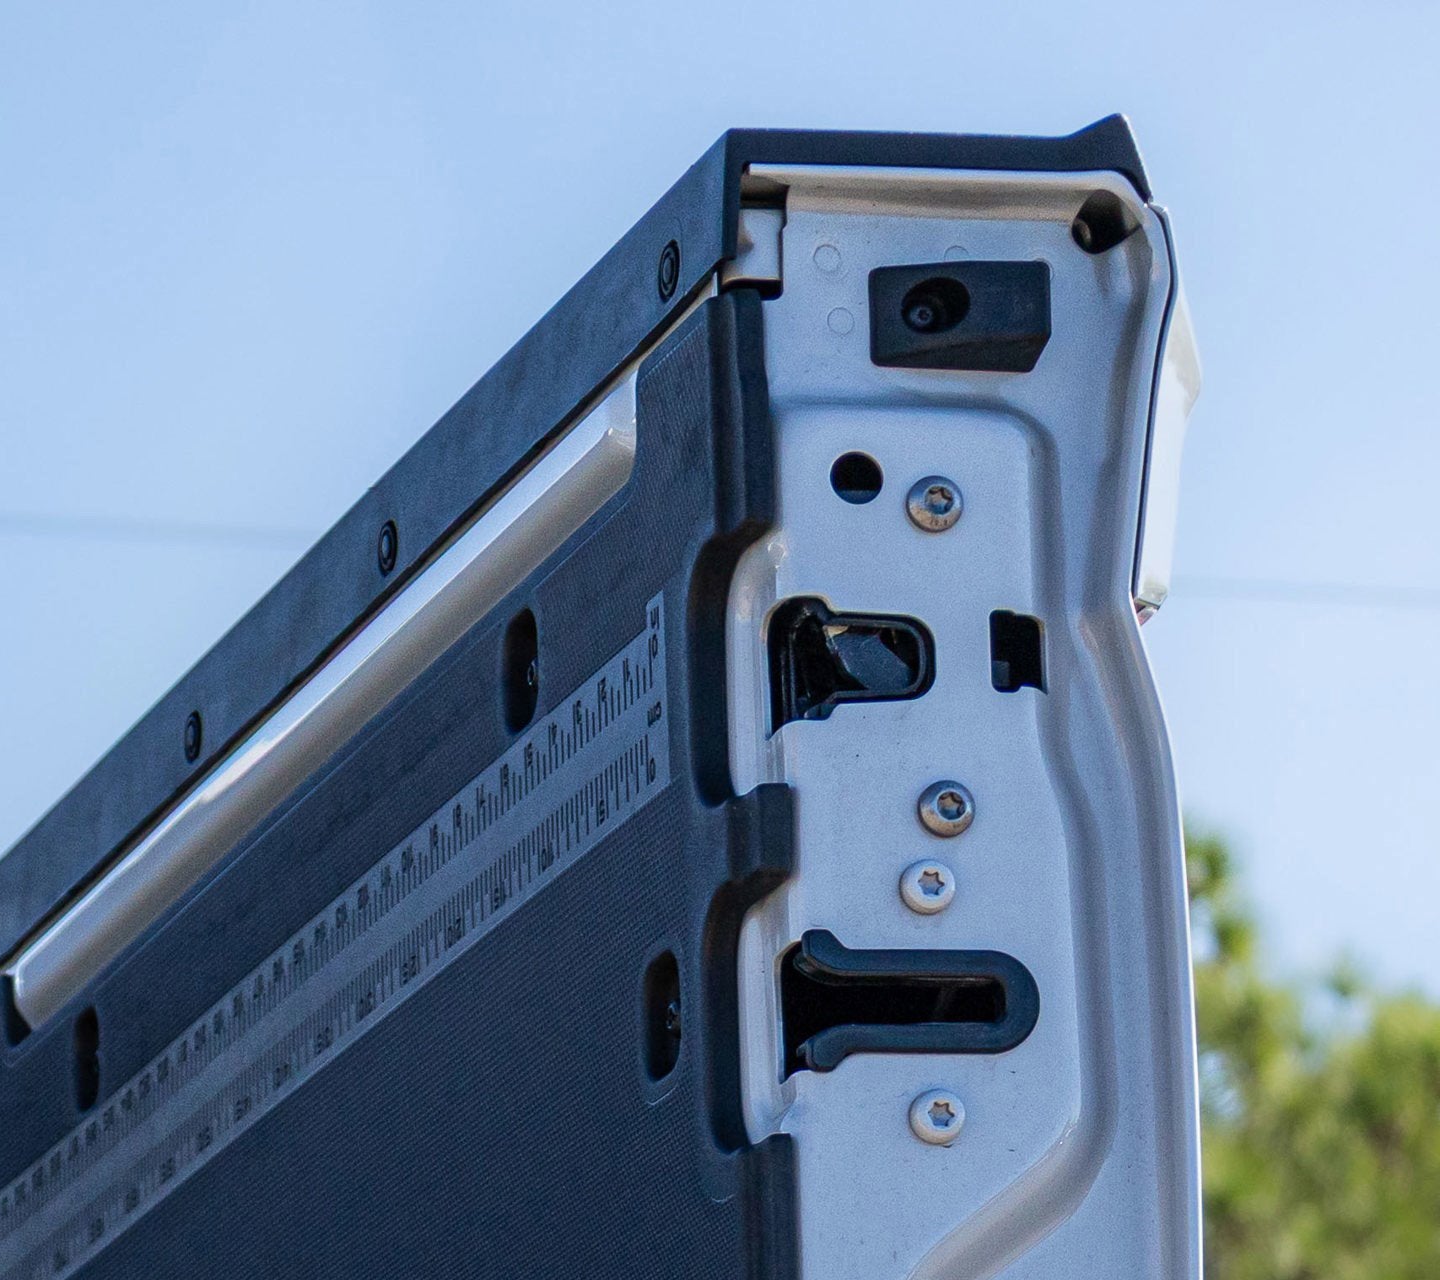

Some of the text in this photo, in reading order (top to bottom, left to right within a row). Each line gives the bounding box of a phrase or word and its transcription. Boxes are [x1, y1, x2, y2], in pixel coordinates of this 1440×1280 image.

[650, 634, 659, 659] 0
[623, 657, 631, 681] 1
[599, 677, 607, 702] 2
[574, 699, 582, 724] 3
[647, 701, 662, 727] cm
[550, 721, 558, 744] 4
[525, 742, 533, 766] 5
[501, 763, 509, 787] 6
[648, 757, 657, 782] 0
[478, 784, 485, 806] 7
[454, 804, 462, 827] 8
[597, 799, 605, 823] 5
[431, 823, 438, 847] 9
[540, 842, 555, 871] 10
